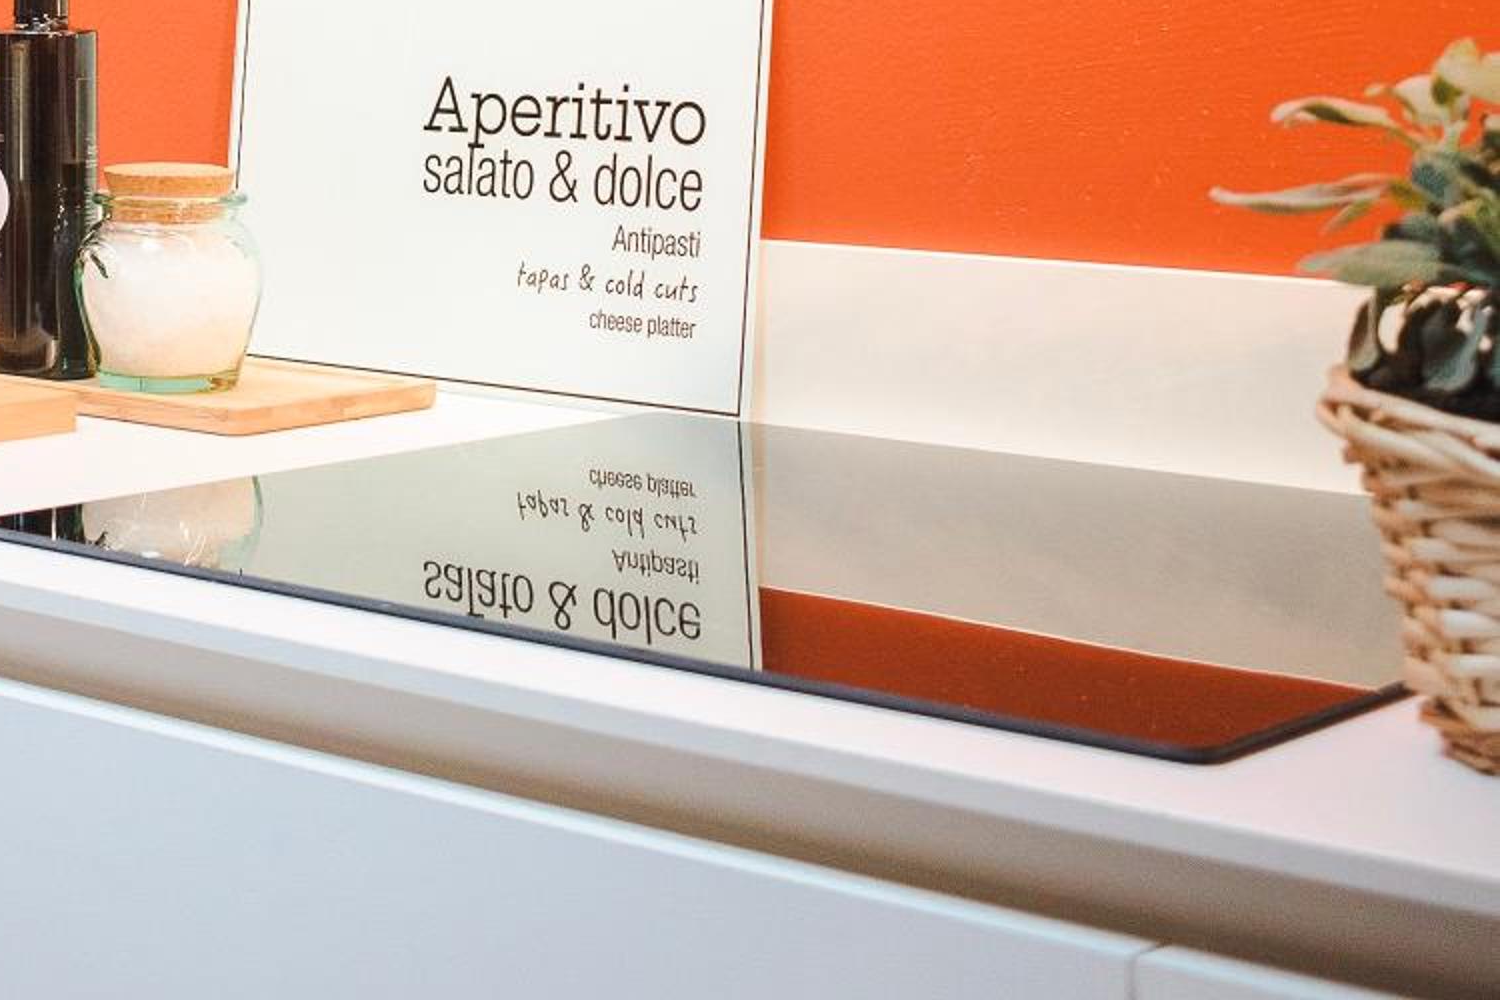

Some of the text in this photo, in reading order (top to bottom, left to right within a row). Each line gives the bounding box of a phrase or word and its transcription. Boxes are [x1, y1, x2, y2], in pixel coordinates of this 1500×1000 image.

[423, 75, 706, 149] Aperitivo
[423, 148, 703, 212] salato & dolce
[611, 224, 701, 260] Antipasti
[516, 261, 699, 303] tapas & cold cuts
[589, 309, 697, 340] cheese platter
